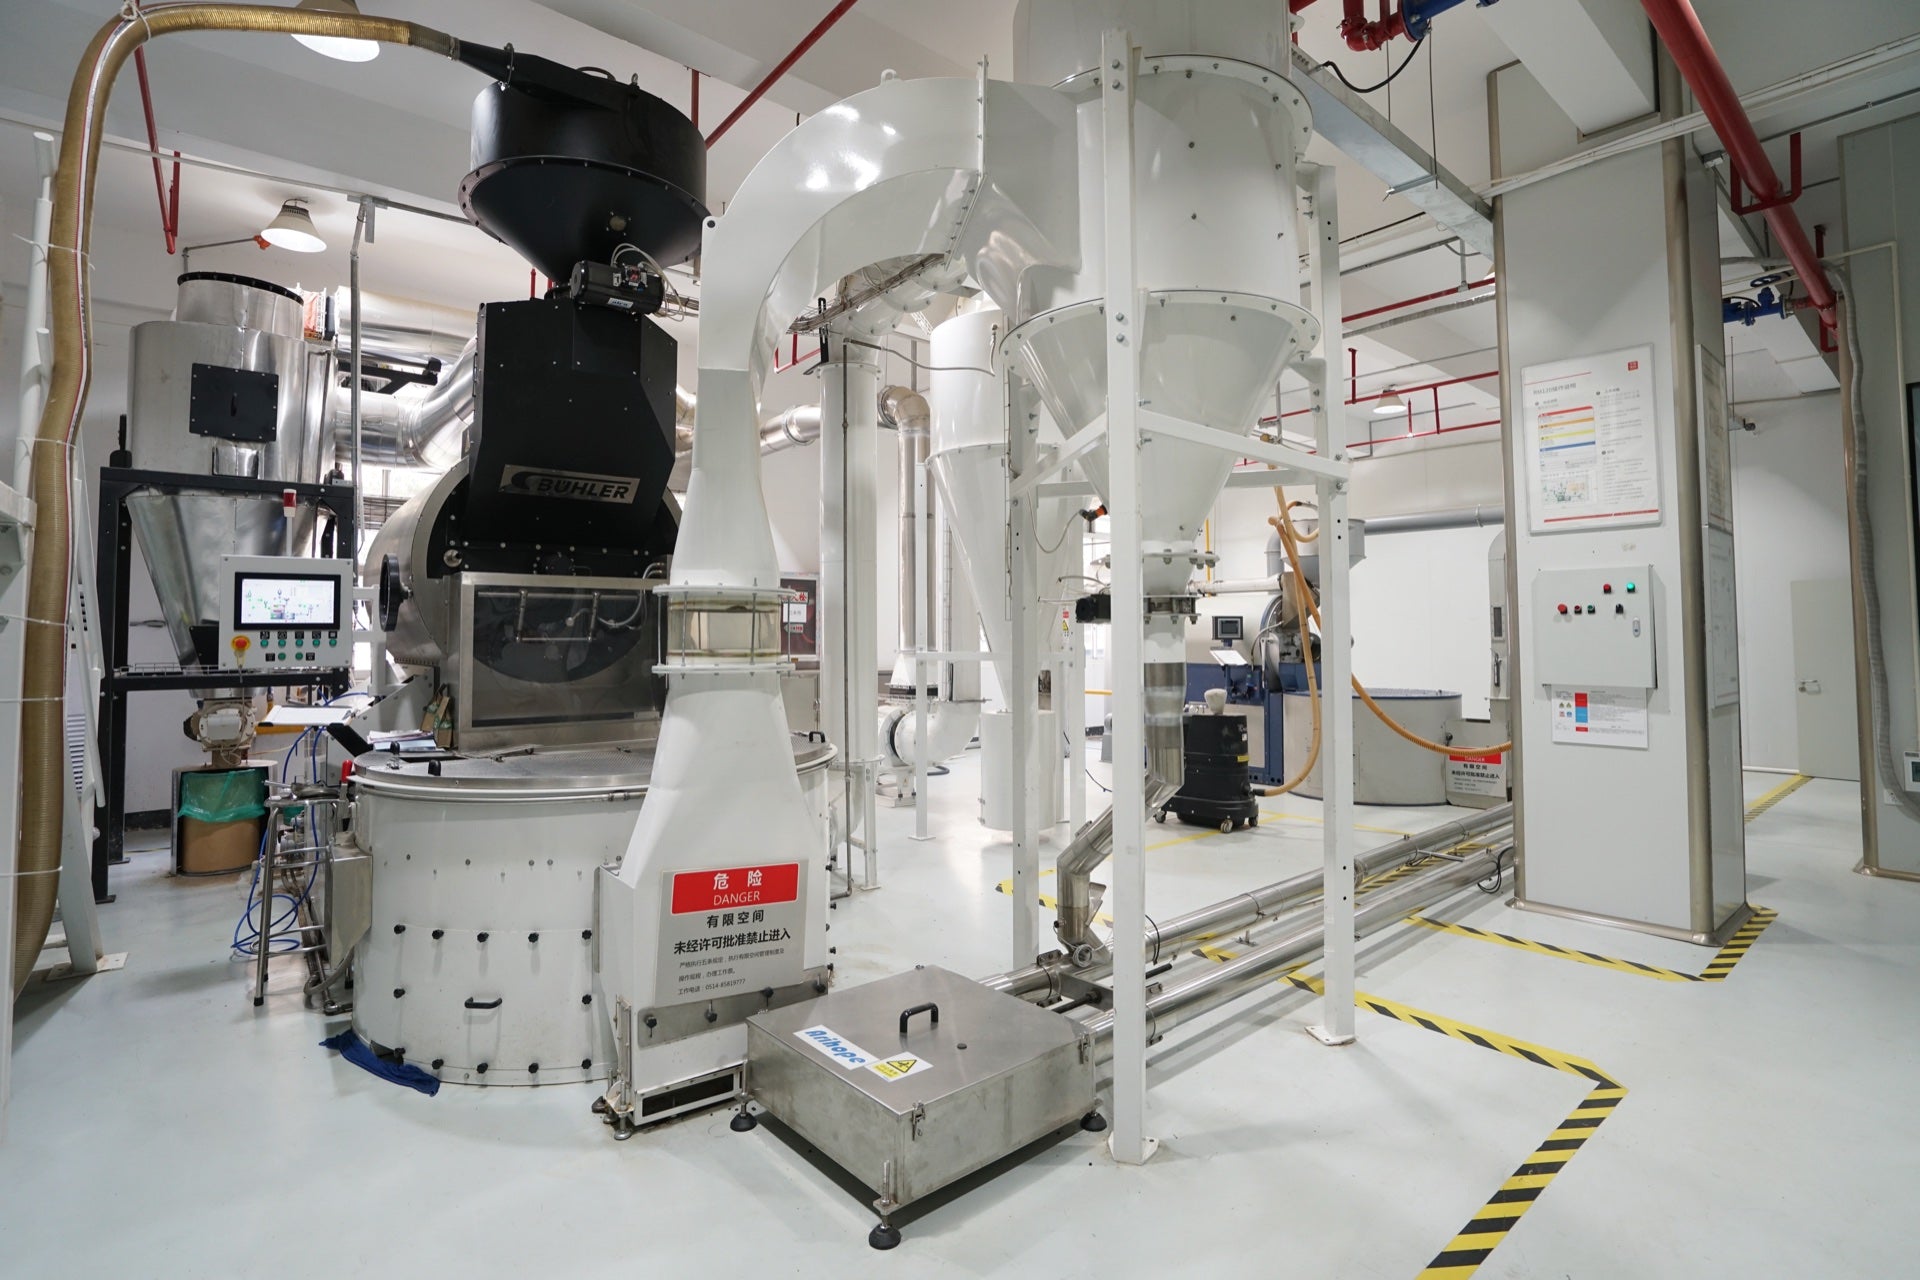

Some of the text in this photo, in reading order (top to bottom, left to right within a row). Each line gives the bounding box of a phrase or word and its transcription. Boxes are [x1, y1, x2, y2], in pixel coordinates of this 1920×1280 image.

[537, 478, 629, 499] BÜHLER
[713, 890, 760, 906] DANGER
[706, 909, 764, 929] 有限空间
[674, 927, 791, 955] 未经许可批准禁止进入
